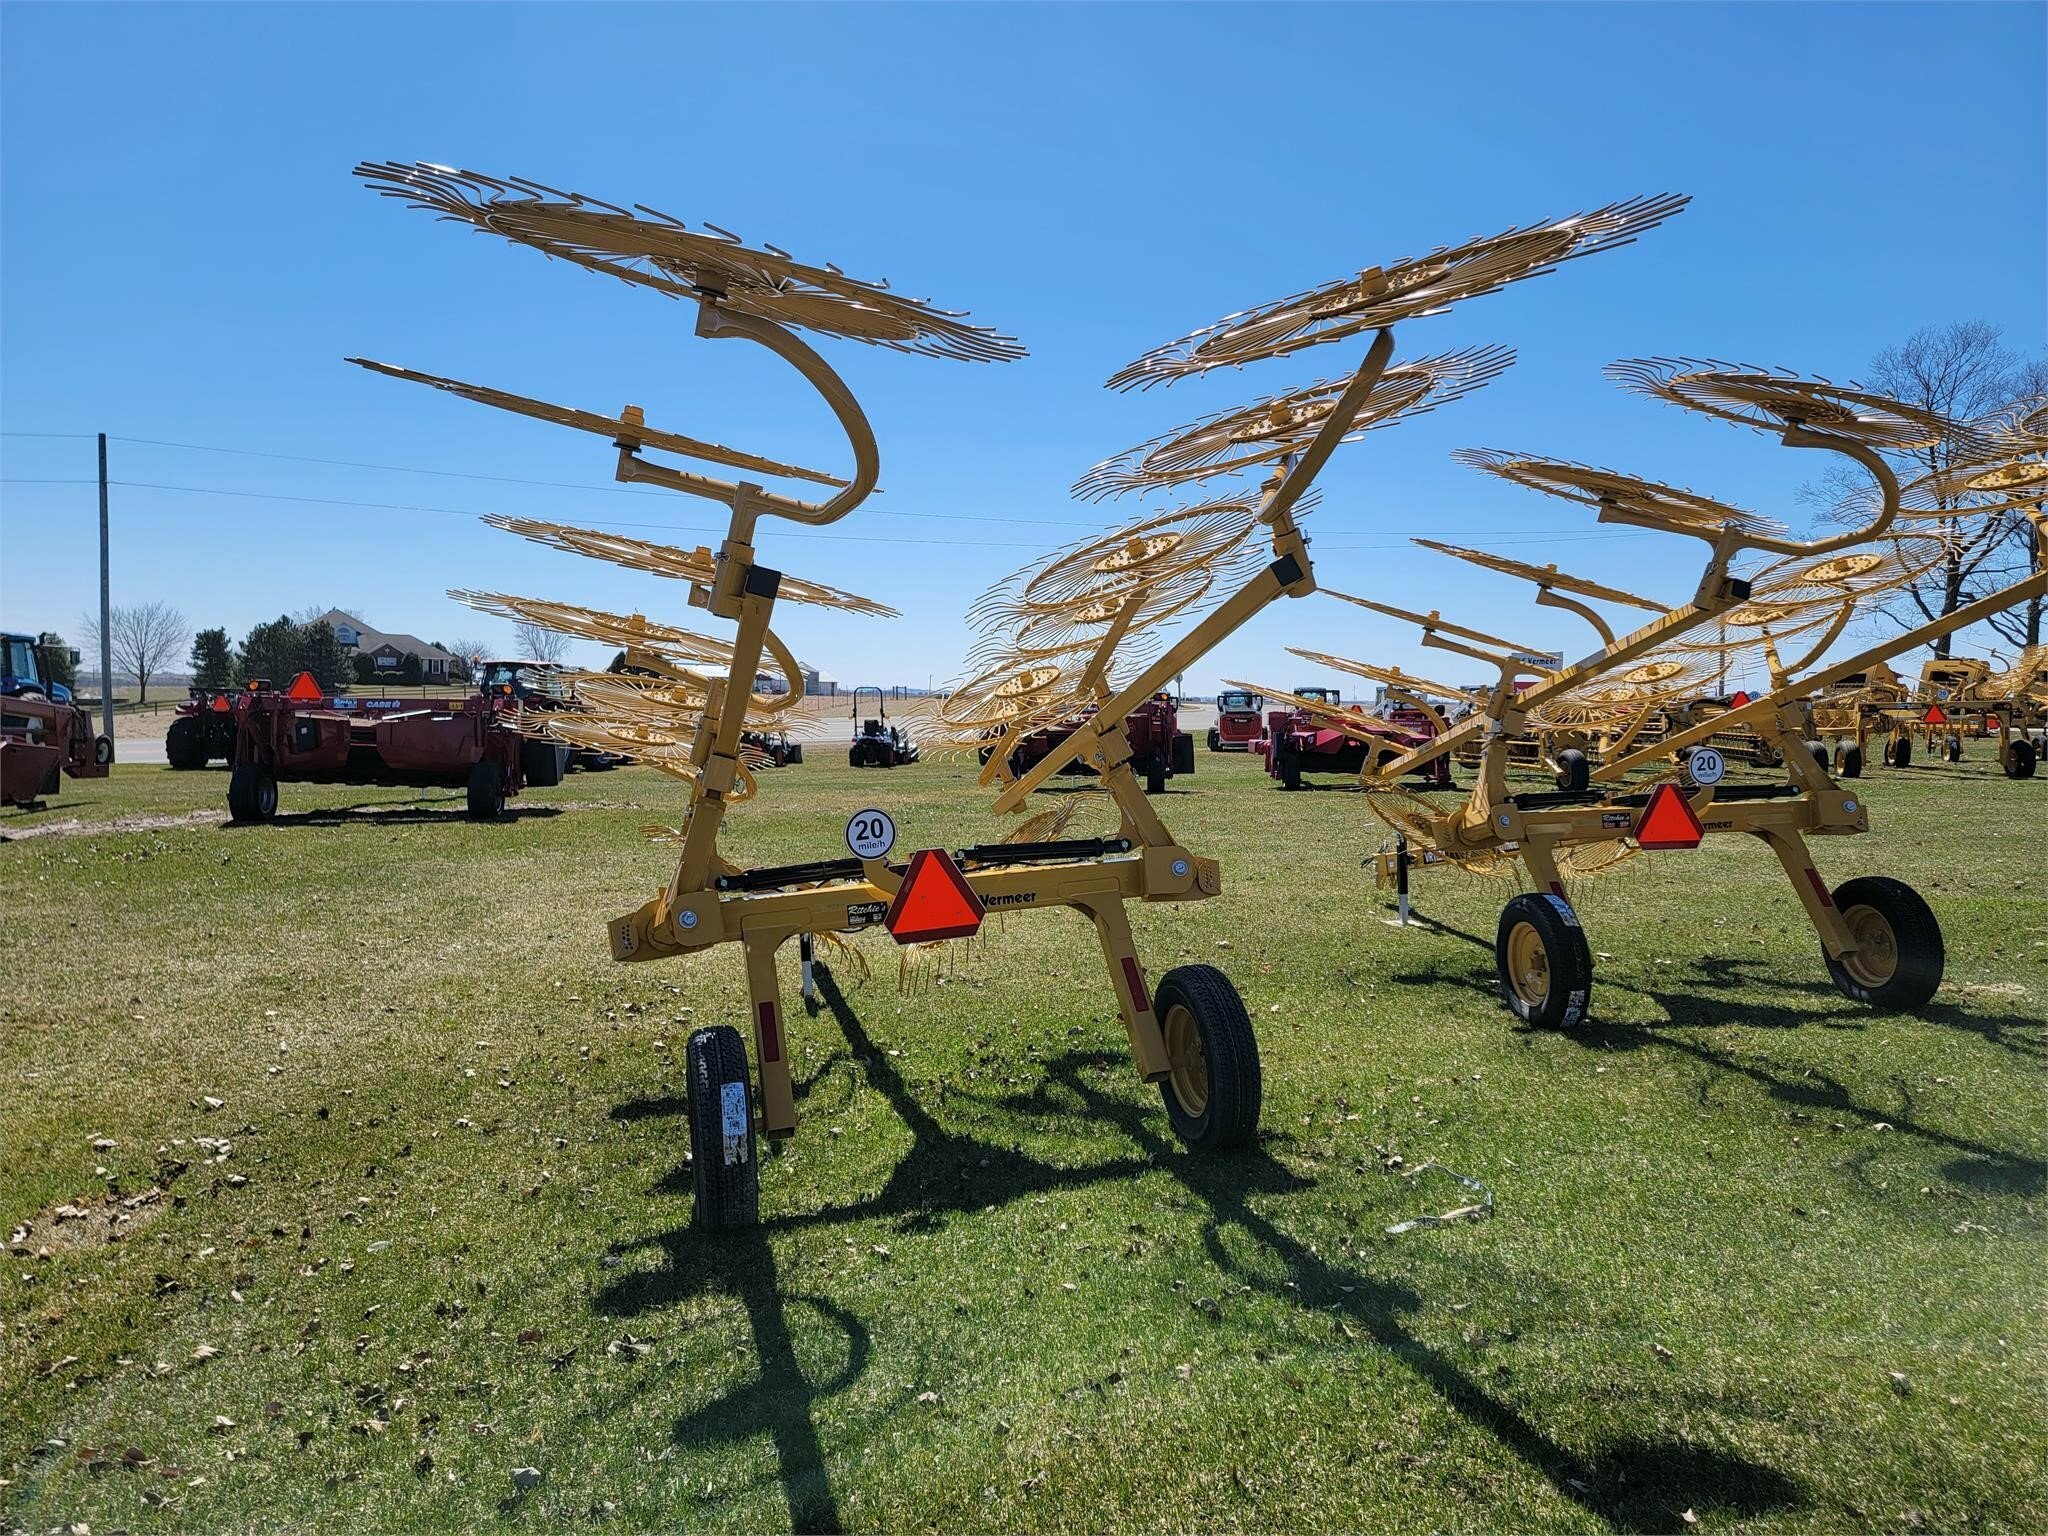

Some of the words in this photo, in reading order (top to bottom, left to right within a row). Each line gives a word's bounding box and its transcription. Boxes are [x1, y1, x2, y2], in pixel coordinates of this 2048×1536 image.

[1696, 755, 1716, 771] 20
[854, 818, 884, 841] 20
[858, 840, 886, 850] mile/h
[979, 892, 1037, 907] Vermeer
[847, 902, 887, 916] Ritchie's
